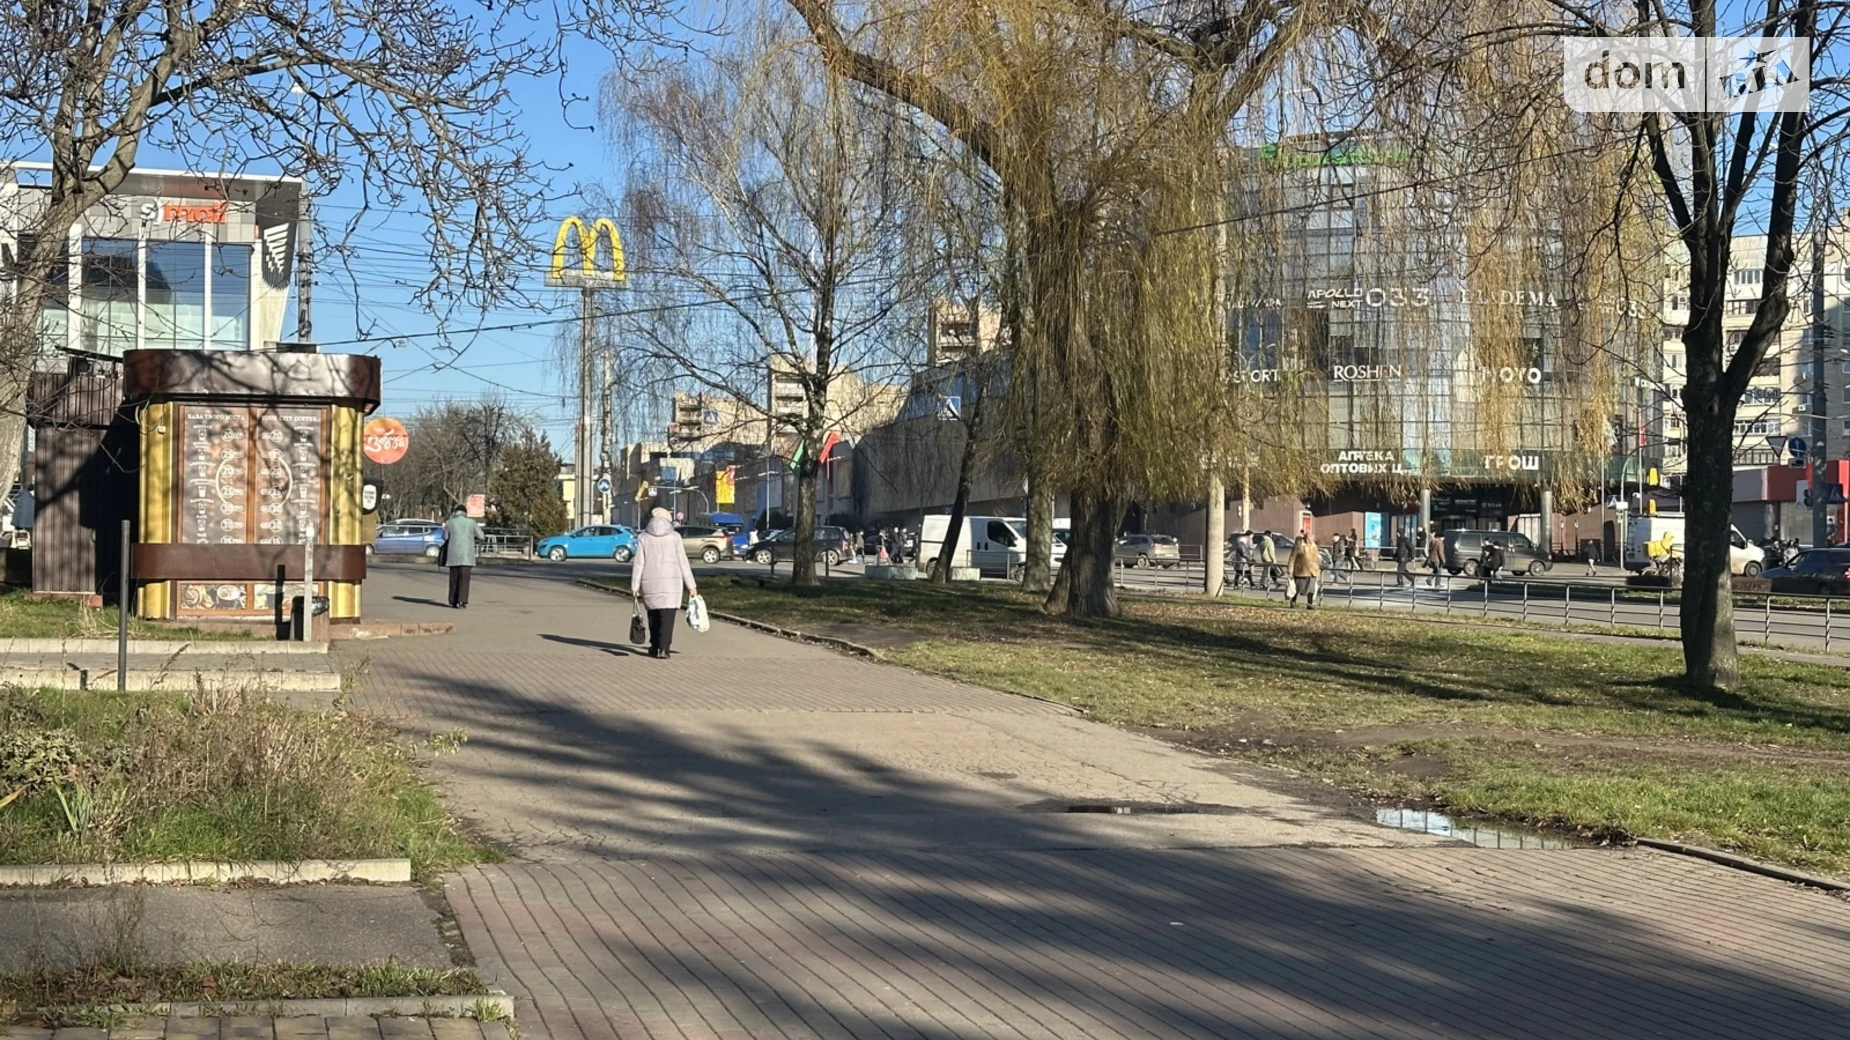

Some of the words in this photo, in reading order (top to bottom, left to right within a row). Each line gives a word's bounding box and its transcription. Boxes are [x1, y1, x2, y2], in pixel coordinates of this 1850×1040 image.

[1307, 288, 1363, 299] APOLLO
[1331, 300, 1363, 309] NEXT
[1338, 451, 1395, 461] АПТЕКА
